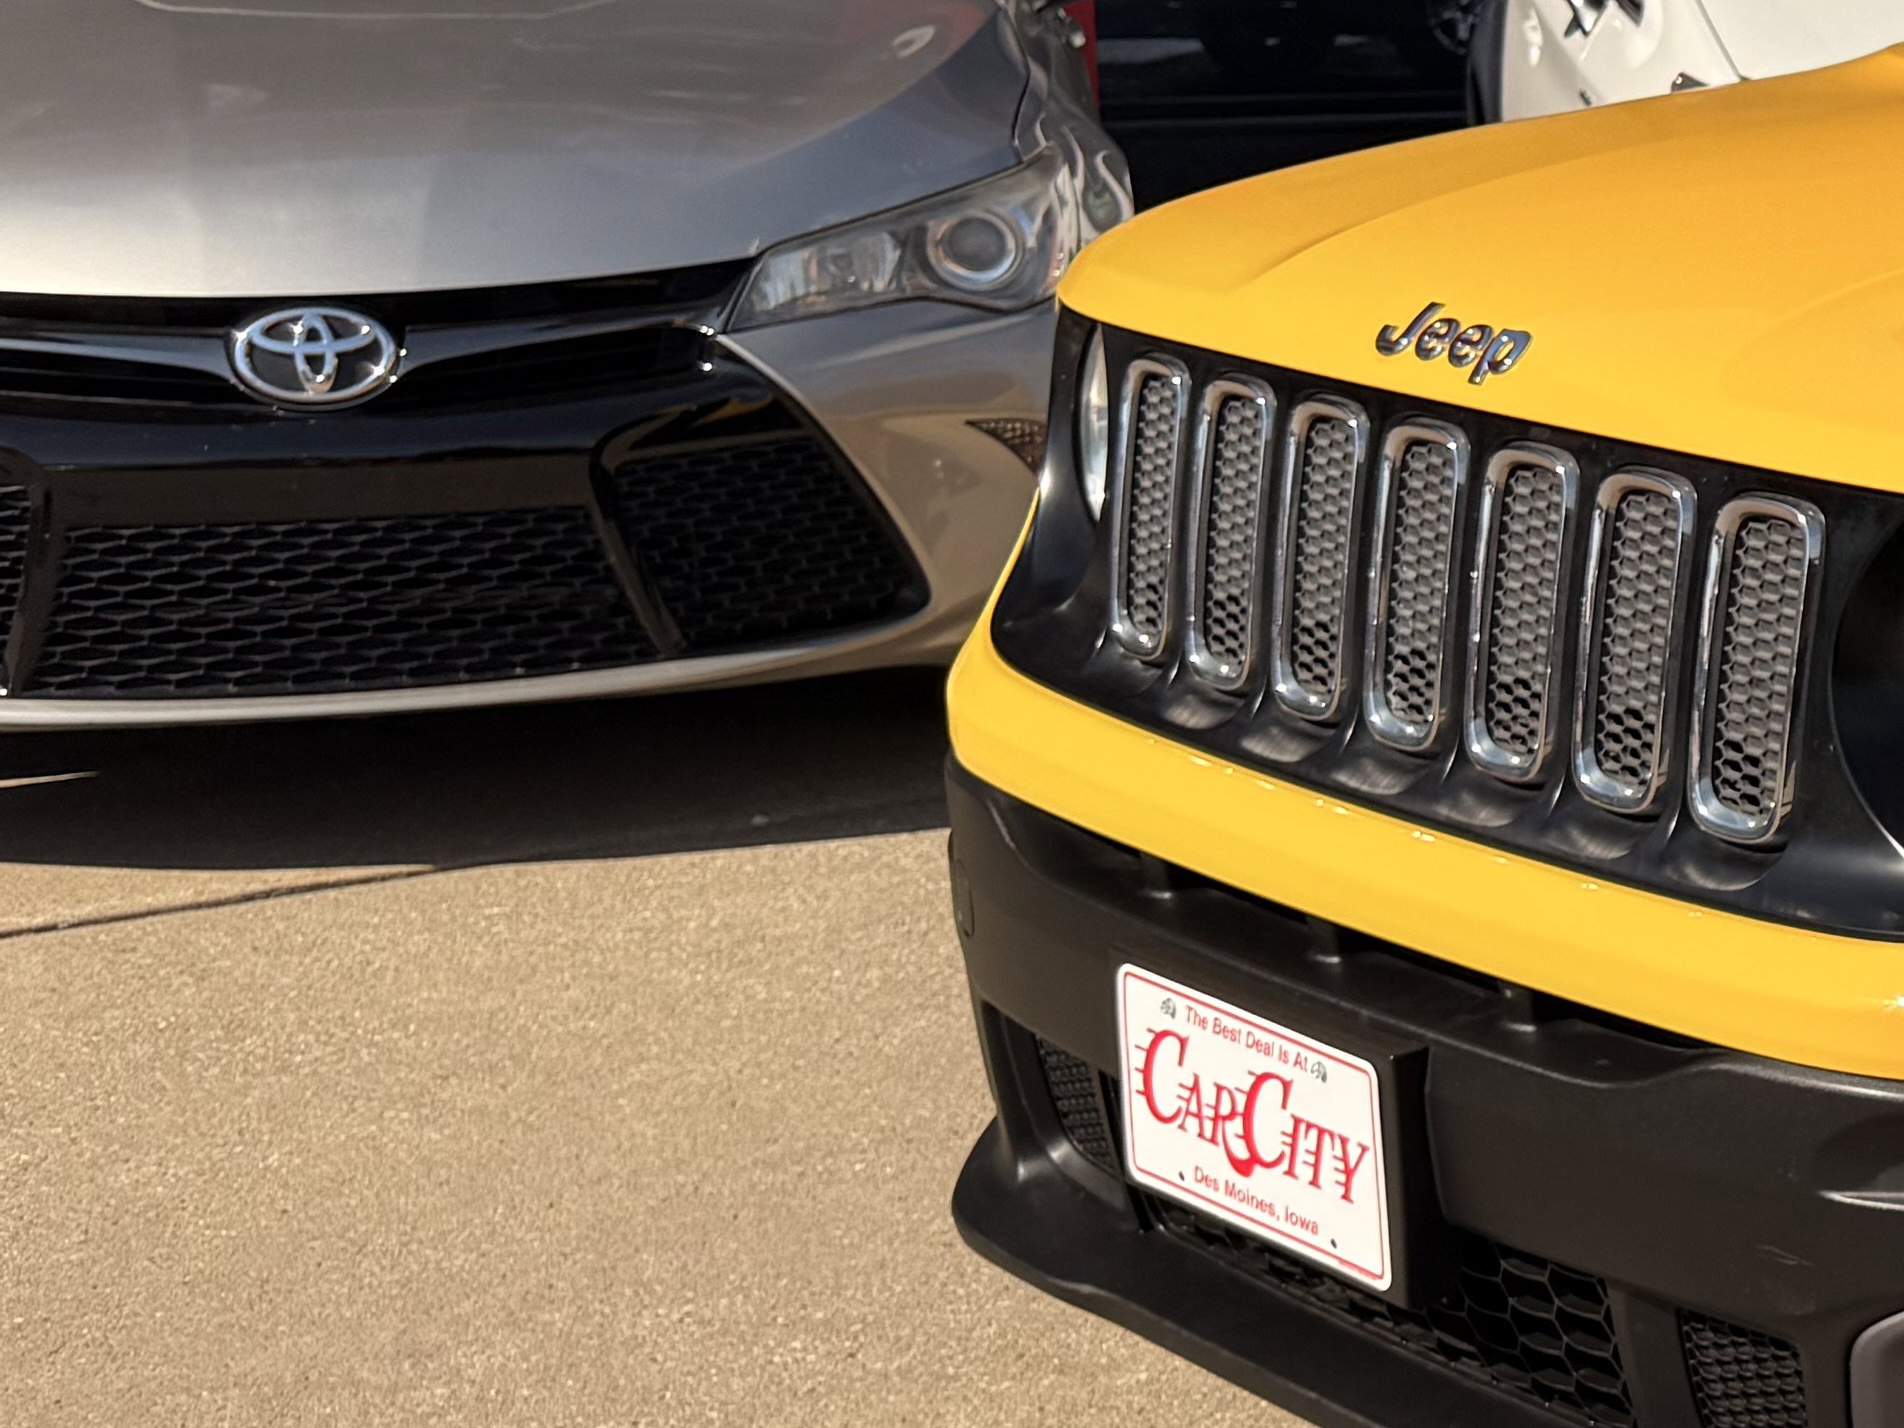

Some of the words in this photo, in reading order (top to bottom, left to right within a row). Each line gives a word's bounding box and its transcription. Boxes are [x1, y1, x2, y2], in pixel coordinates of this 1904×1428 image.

[1375, 301, 1533, 386] Jeep
[1184, 1004, 1209, 1031] The
[1213, 1016, 1241, 1046] Best
[1246, 1029, 1275, 1058] Deal
[1279, 1043, 1291, 1064] Is
[1294, 1051, 1309, 1071] At
[1193, 1165, 1220, 1193] Des
[1224, 1181, 1281, 1221] Moines,
[1285, 1204, 1320, 1236] Iowa
